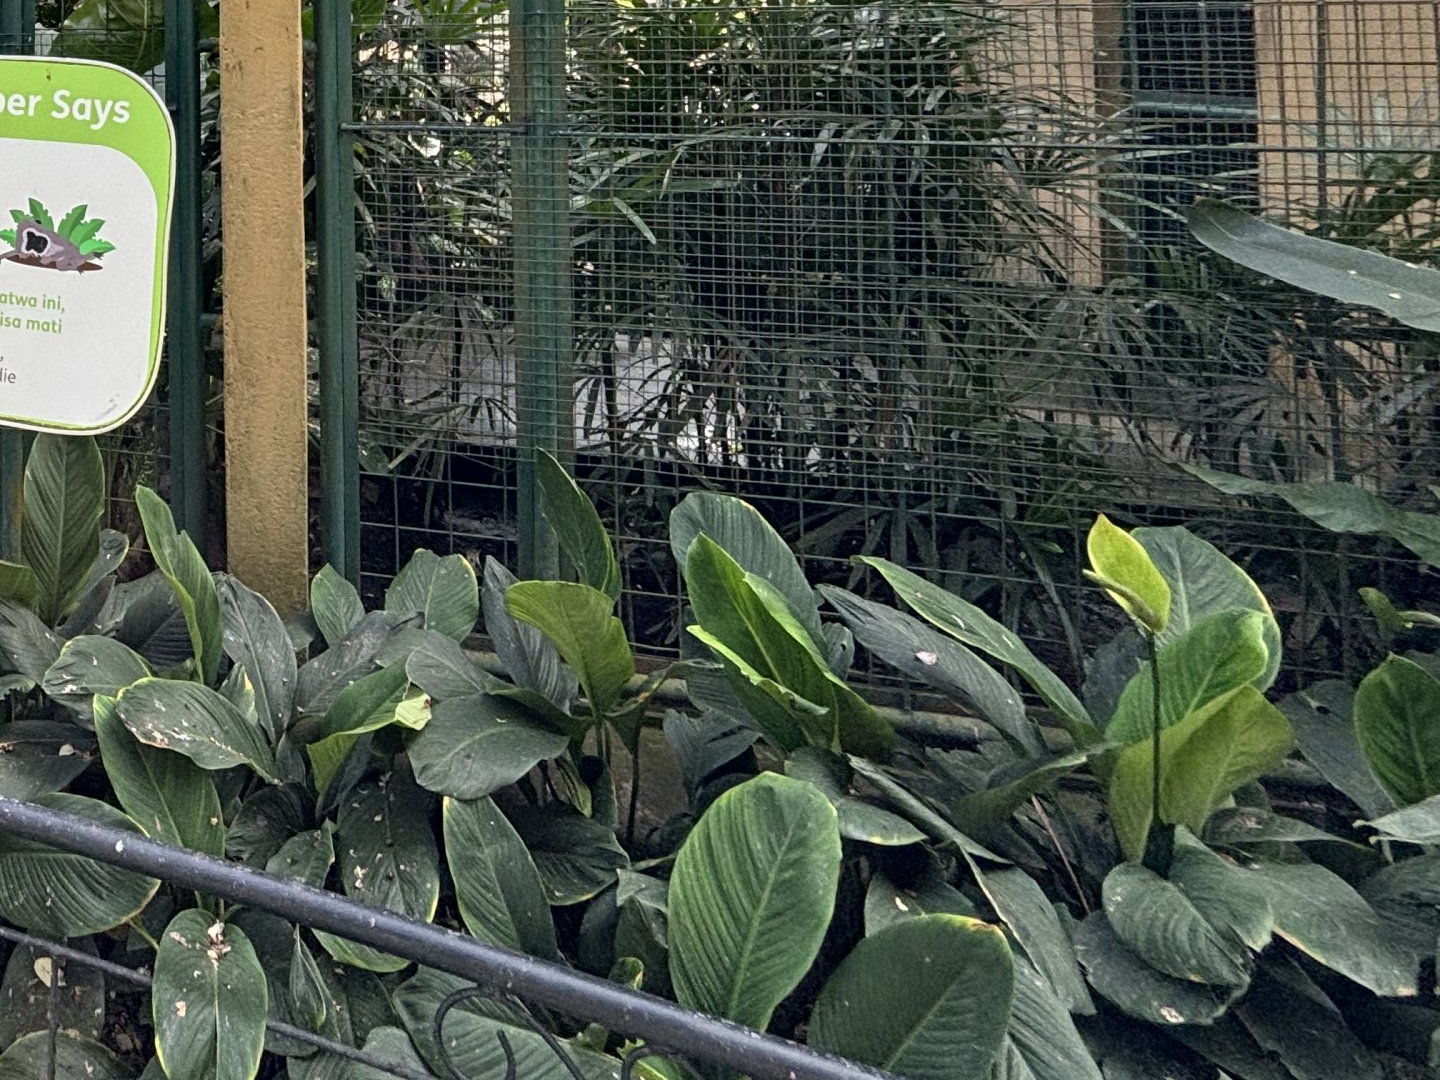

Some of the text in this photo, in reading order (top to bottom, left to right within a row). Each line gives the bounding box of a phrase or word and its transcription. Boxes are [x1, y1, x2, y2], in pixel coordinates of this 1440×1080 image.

[51, 90, 130, 130] Says
[43, 295, 66, 314] ini,
[26, 318, 63, 334] mati
